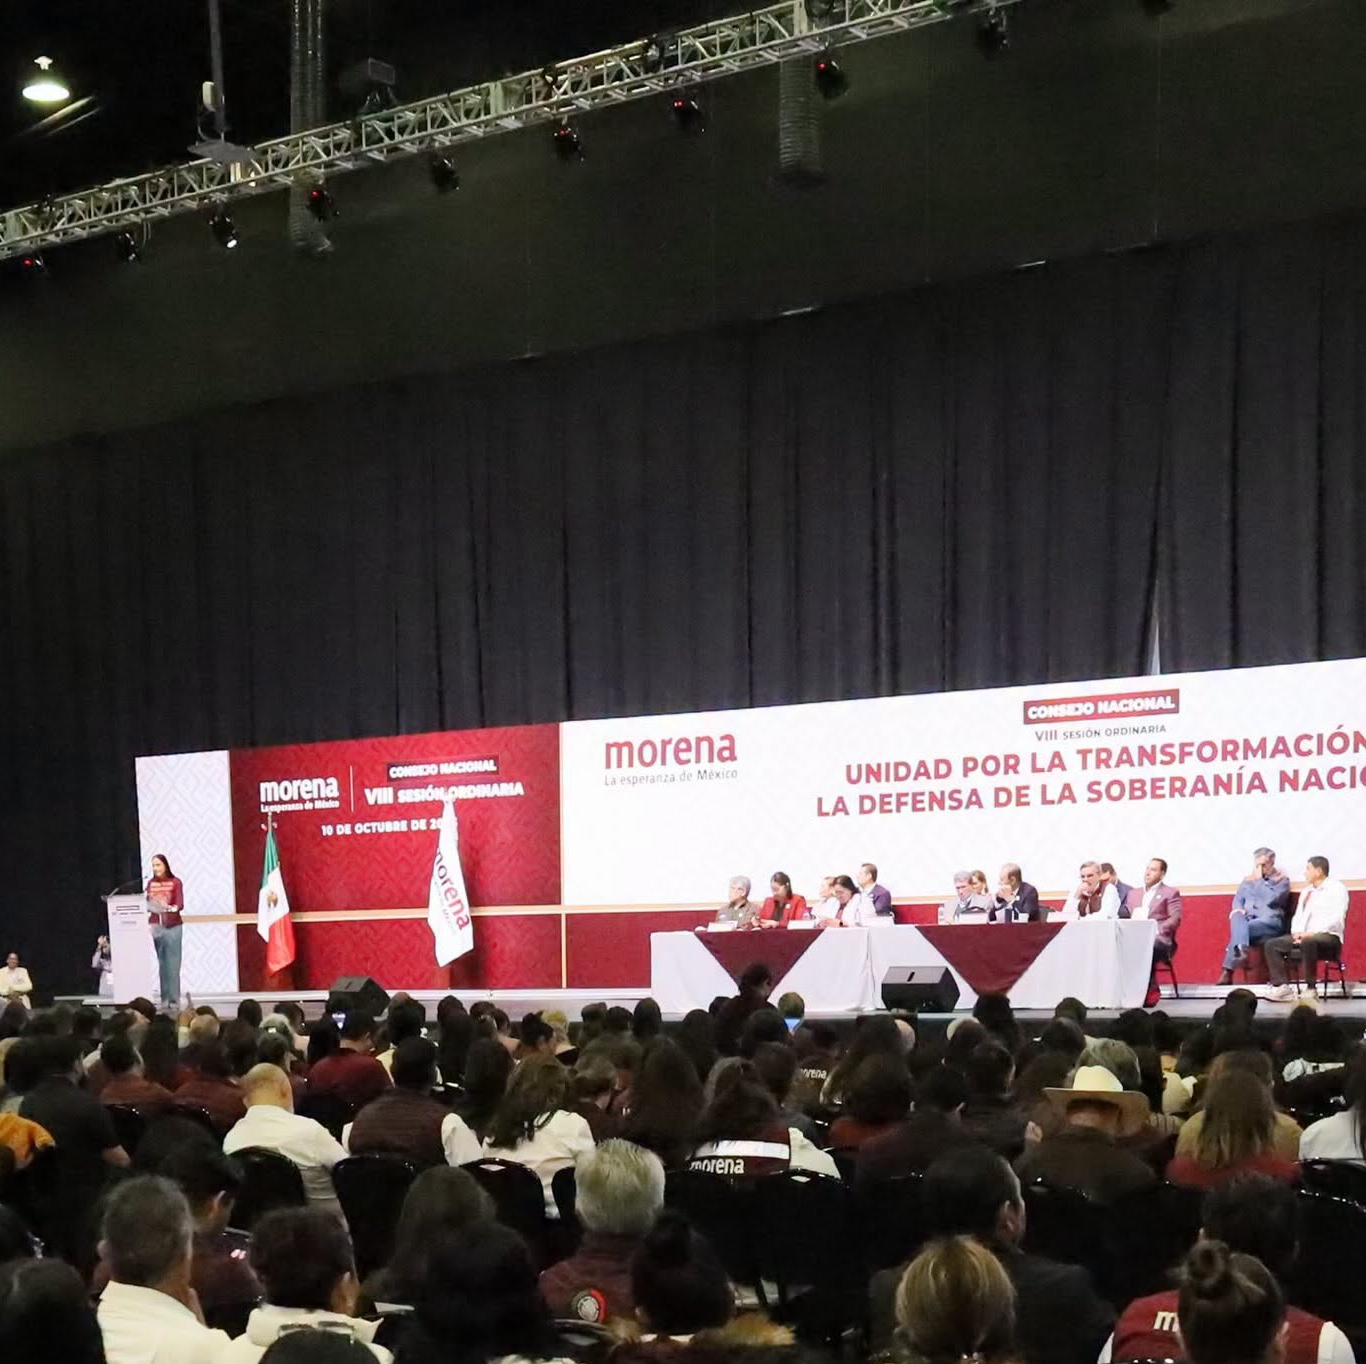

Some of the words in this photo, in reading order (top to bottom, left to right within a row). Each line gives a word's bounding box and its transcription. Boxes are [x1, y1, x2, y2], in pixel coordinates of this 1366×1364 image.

[1027, 702, 1095, 720] CONSEJO
[1097, 696, 1176, 714] NACIONAL
[1035, 729, 1058, 742] VIII
[1063, 728, 1101, 741] SESIÓN
[1104, 724, 1167, 737] ORDINARIA
[604, 733, 738, 770] morena
[389, 763, 438, 778] CONSEJO
[439, 759, 497, 774] NACIONAL
[604, 775, 617, 786] La
[619, 772, 676, 787] esperanza
[678, 769, 693, 782] de
[696, 767, 738, 781] México
[845, 758, 953, 785] UNIDAD
[962, 753, 1021, 778] POR
[1030, 750, 1067, 773] LA
[260, 776, 340, 802] morena
[364, 786, 394, 805] VIII
[397, 784, 445, 804] SESIÓN
[448, 781, 525, 800] ORDINARIA
[817, 795, 850, 817] LA
[858, 787, 984, 815] DEFENSA
[993, 784, 1031, 808] DE
[1040, 782, 1077, 805] LA
[1086, 766, 1268, 803] SOBERANÍA
[321, 824, 334, 836] 10
[336, 823, 352, 836] DE
[354, 819, 408, 834] OCTUBRE
[410, 818, 427, 831] DE
